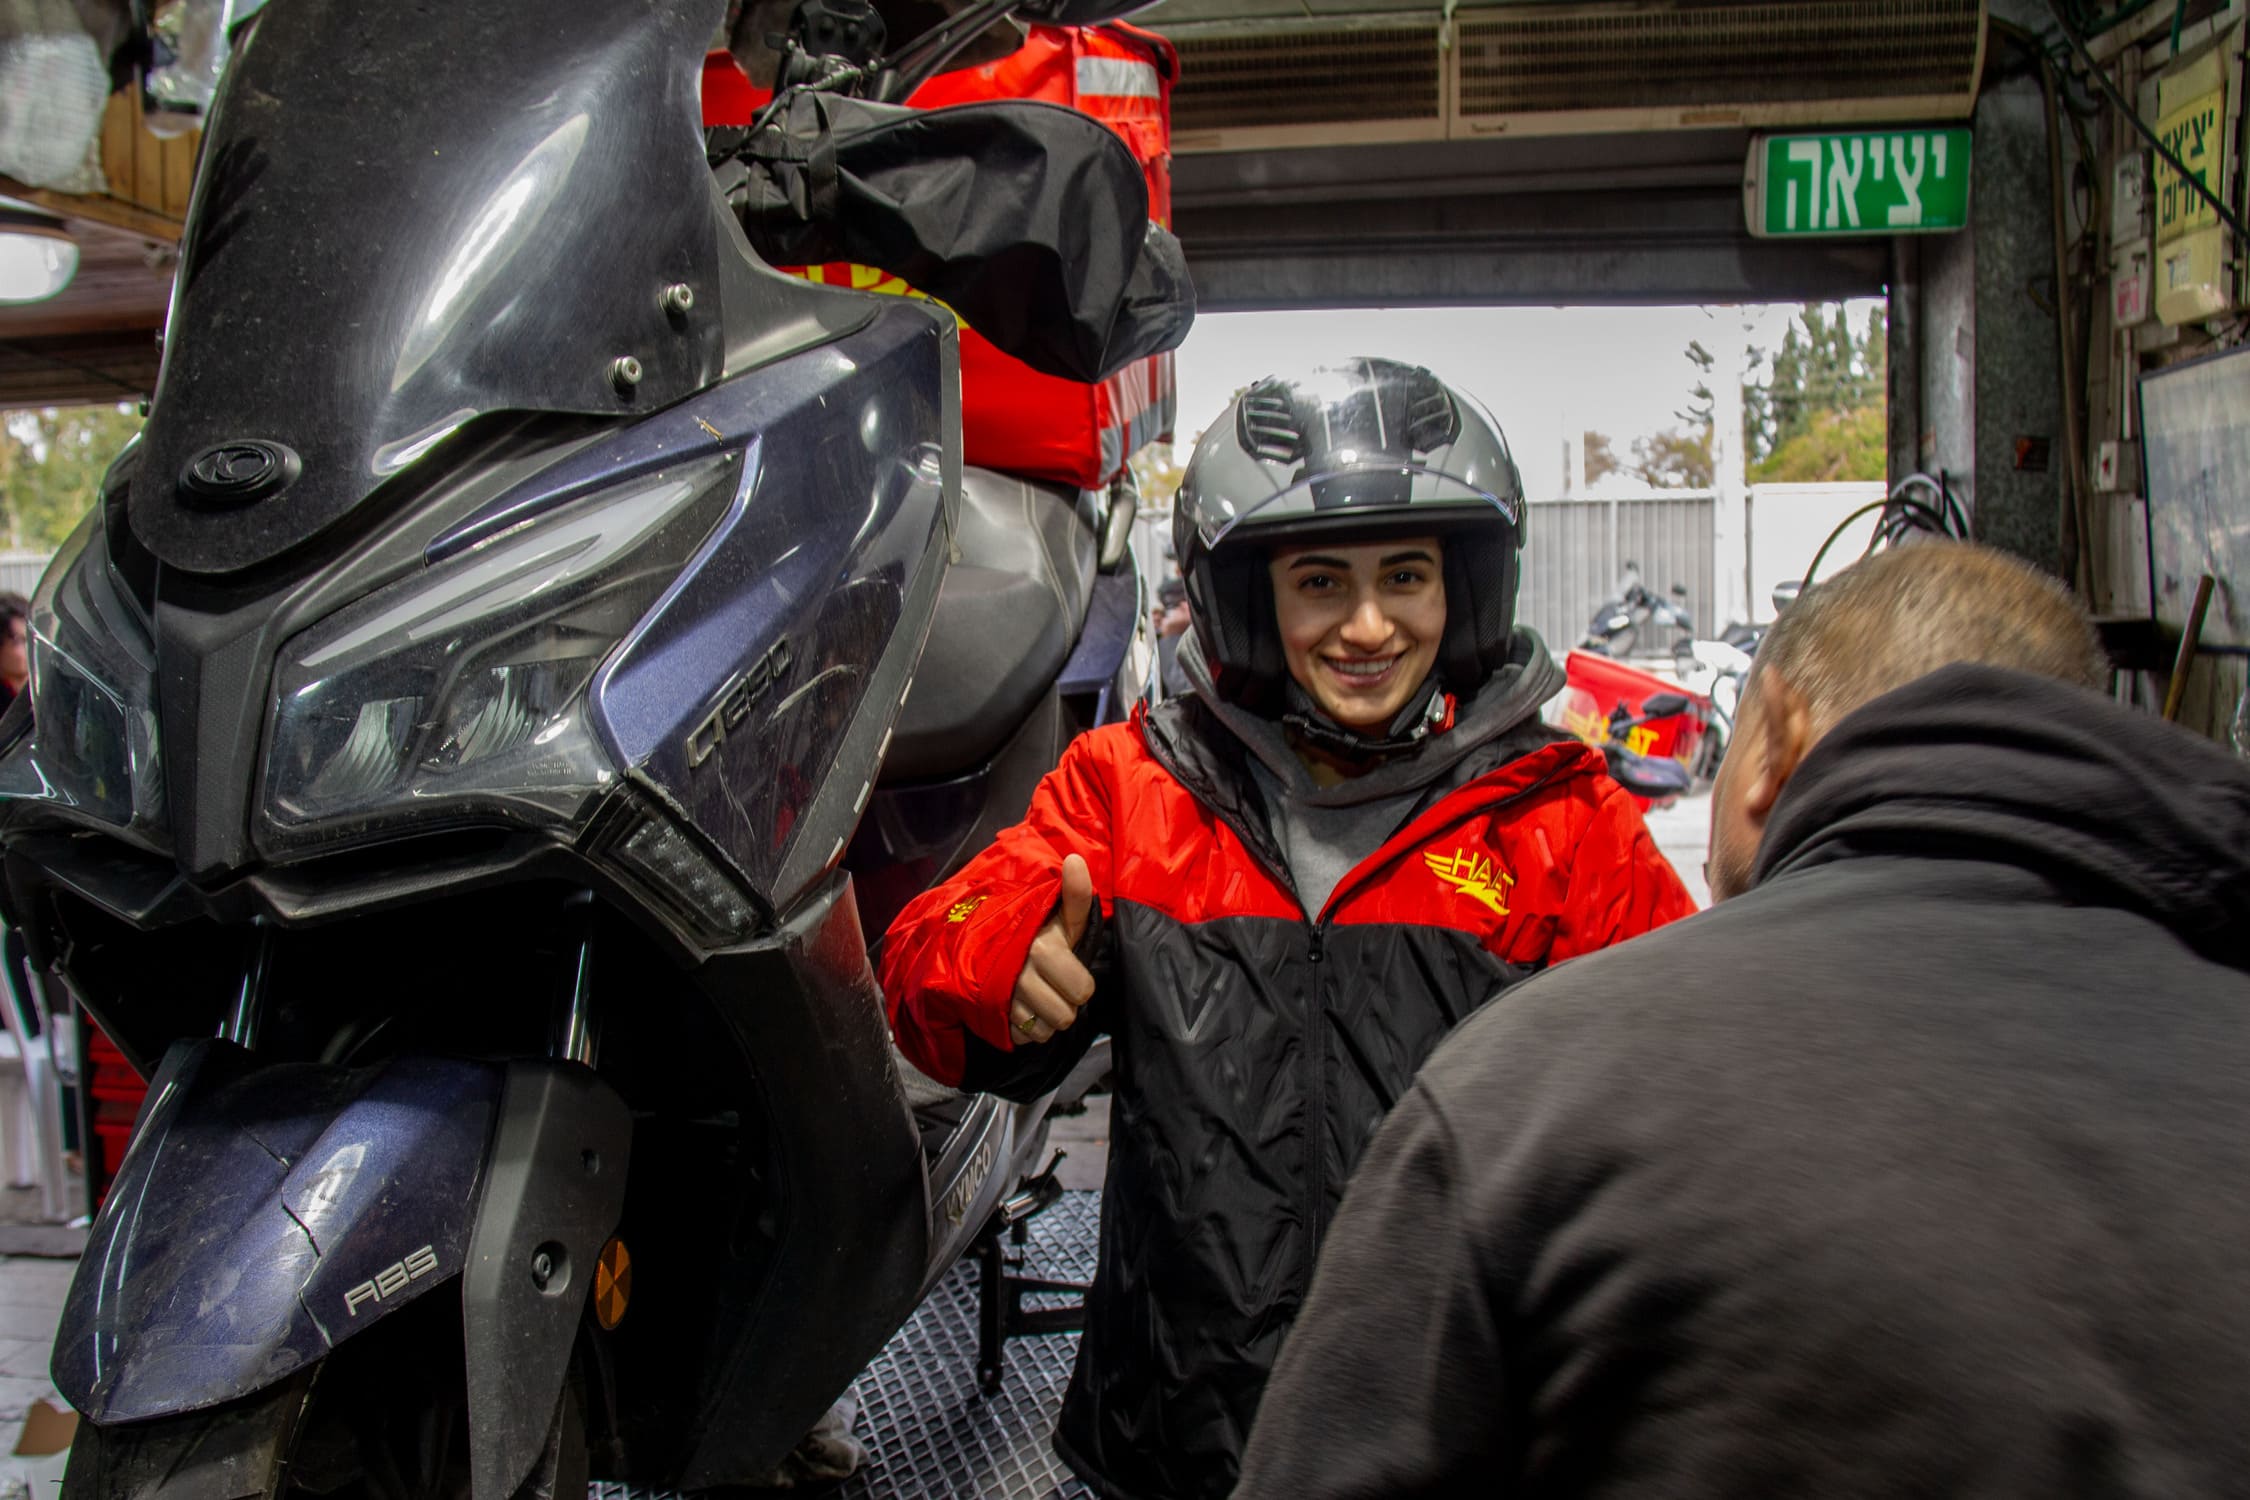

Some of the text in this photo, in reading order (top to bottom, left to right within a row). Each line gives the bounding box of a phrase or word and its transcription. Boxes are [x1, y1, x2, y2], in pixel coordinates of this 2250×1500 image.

[1786, 135, 1948, 229] יציאה
[945, 1141, 991, 1228] KYMCO
[343, 1244, 439, 1317] ABS
